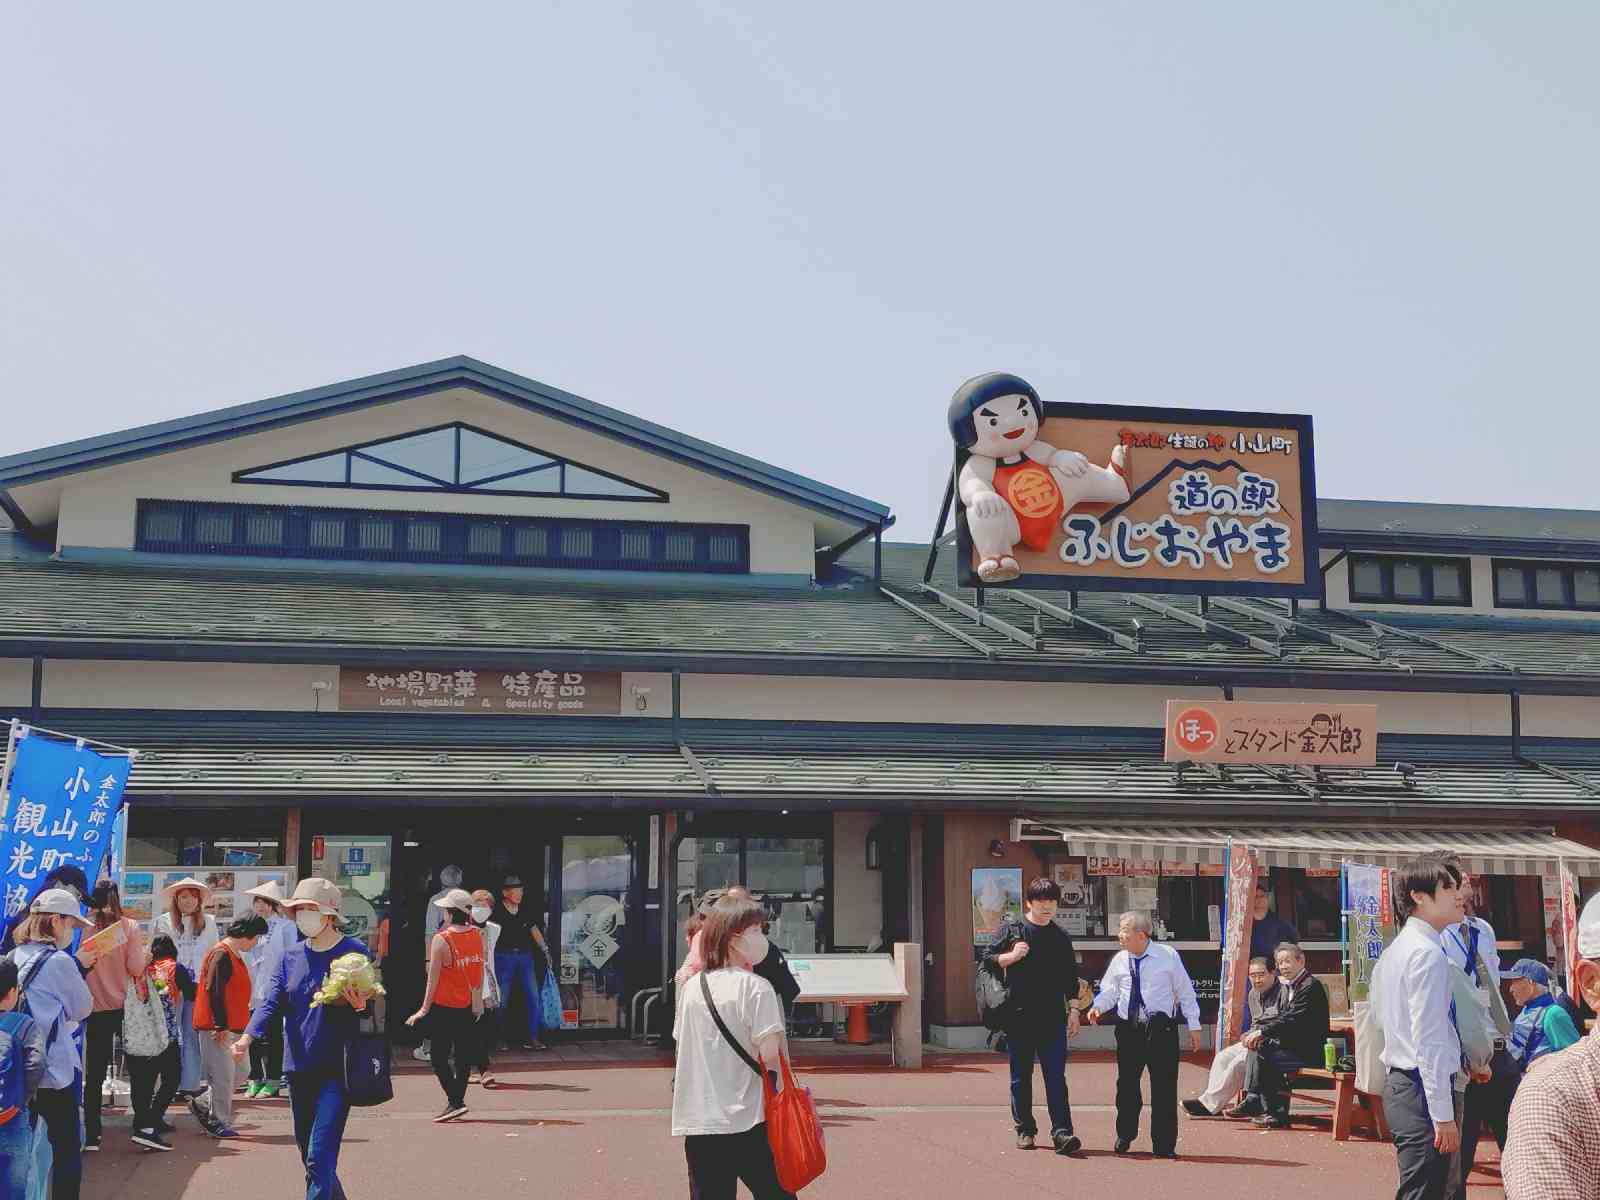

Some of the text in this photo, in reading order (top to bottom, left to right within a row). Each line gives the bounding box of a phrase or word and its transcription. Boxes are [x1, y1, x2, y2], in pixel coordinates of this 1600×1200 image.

[1231, 431, 1293, 454] 小山町
[1171, 471, 1281, 514] 道の駅
[1061, 515, 1290, 572] ふじおやま
[365, 670, 586, 698] 地場野菜 特産品
[379, 695, 406, 707] Local
[411, 695, 465, 708] vegetables
[505, 698, 553, 710] Specialty
[557, 699, 585, 711] goods
[1365, 895, 1383, 961] 金太郎
[590, 938, 609, 958] 金
